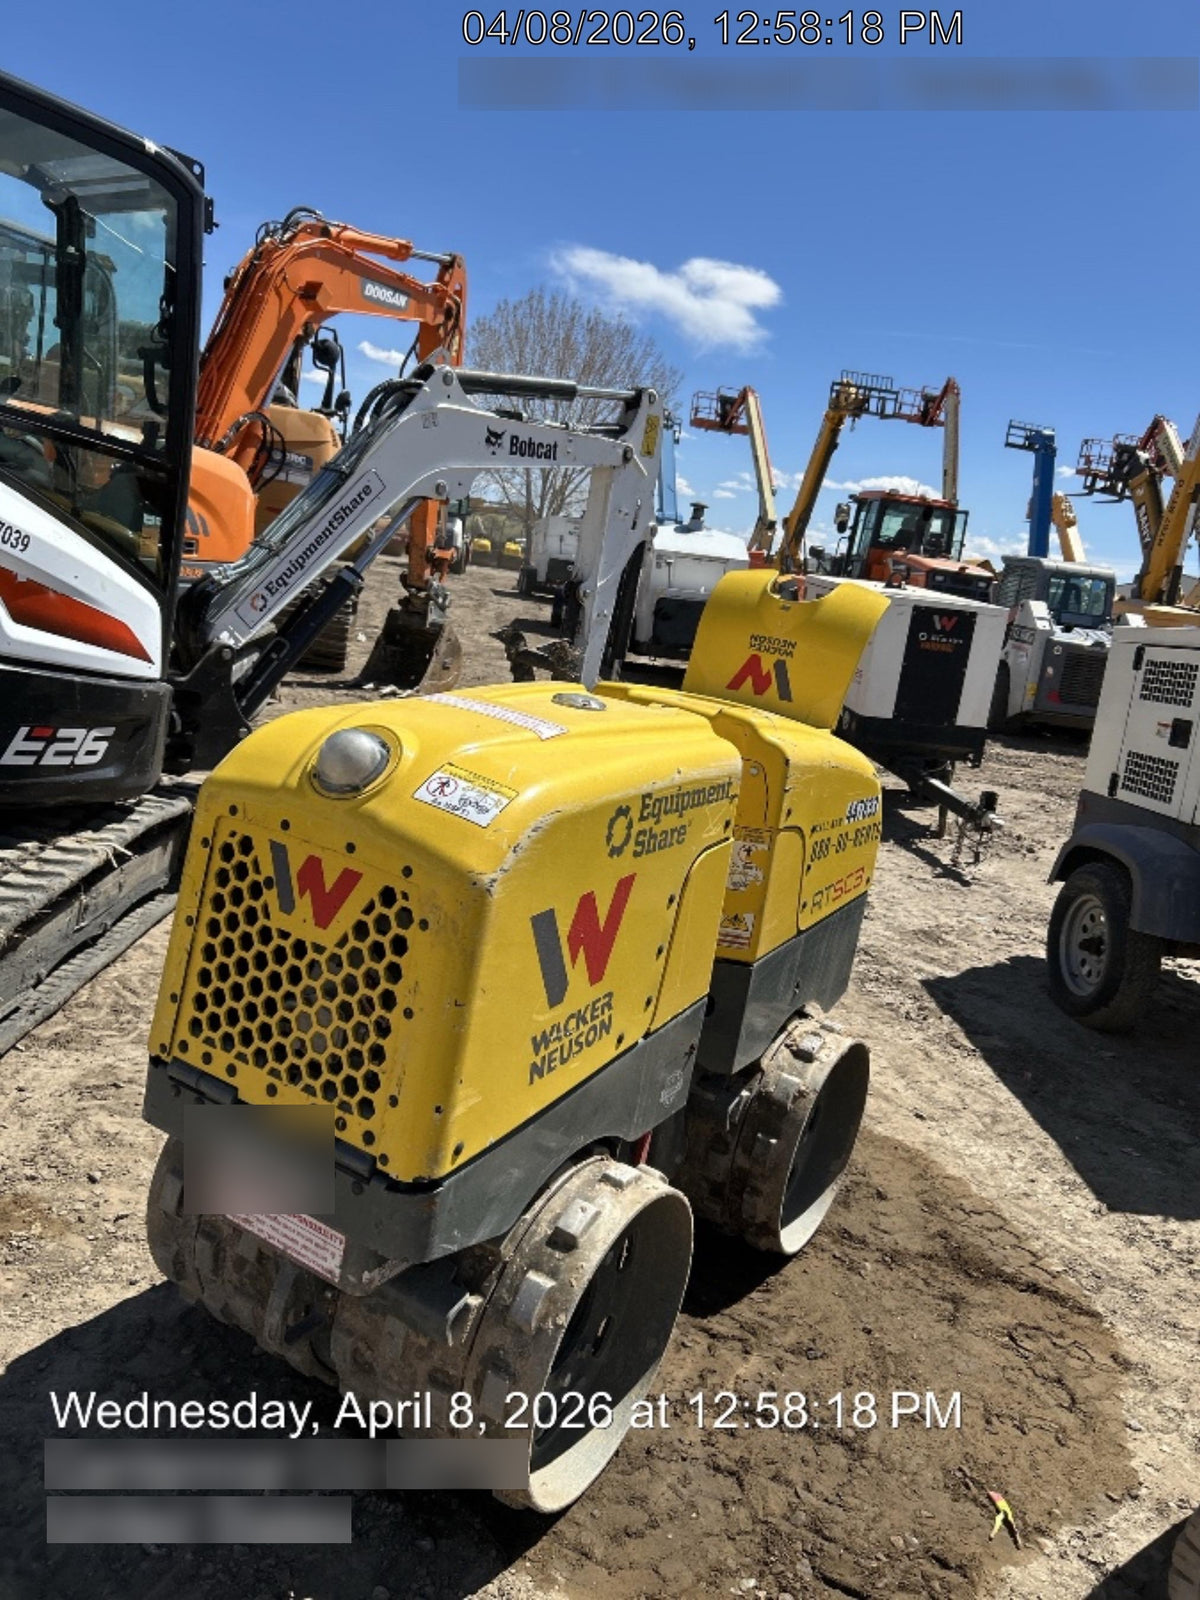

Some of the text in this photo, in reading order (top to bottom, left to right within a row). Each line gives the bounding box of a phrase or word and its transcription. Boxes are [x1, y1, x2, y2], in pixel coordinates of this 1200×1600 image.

[364, 283, 408, 308] DOOSAN
[509, 435, 558, 460] Bobcat
[264, 484, 372, 598] EquipmentShare
[0, 726, 116, 766] E26
[638, 777, 735, 826] Equipment
[632, 823, 688, 858] Share
[530, 991, 614, 1057] WACKER
[528, 1014, 613, 1087] NEUSON
